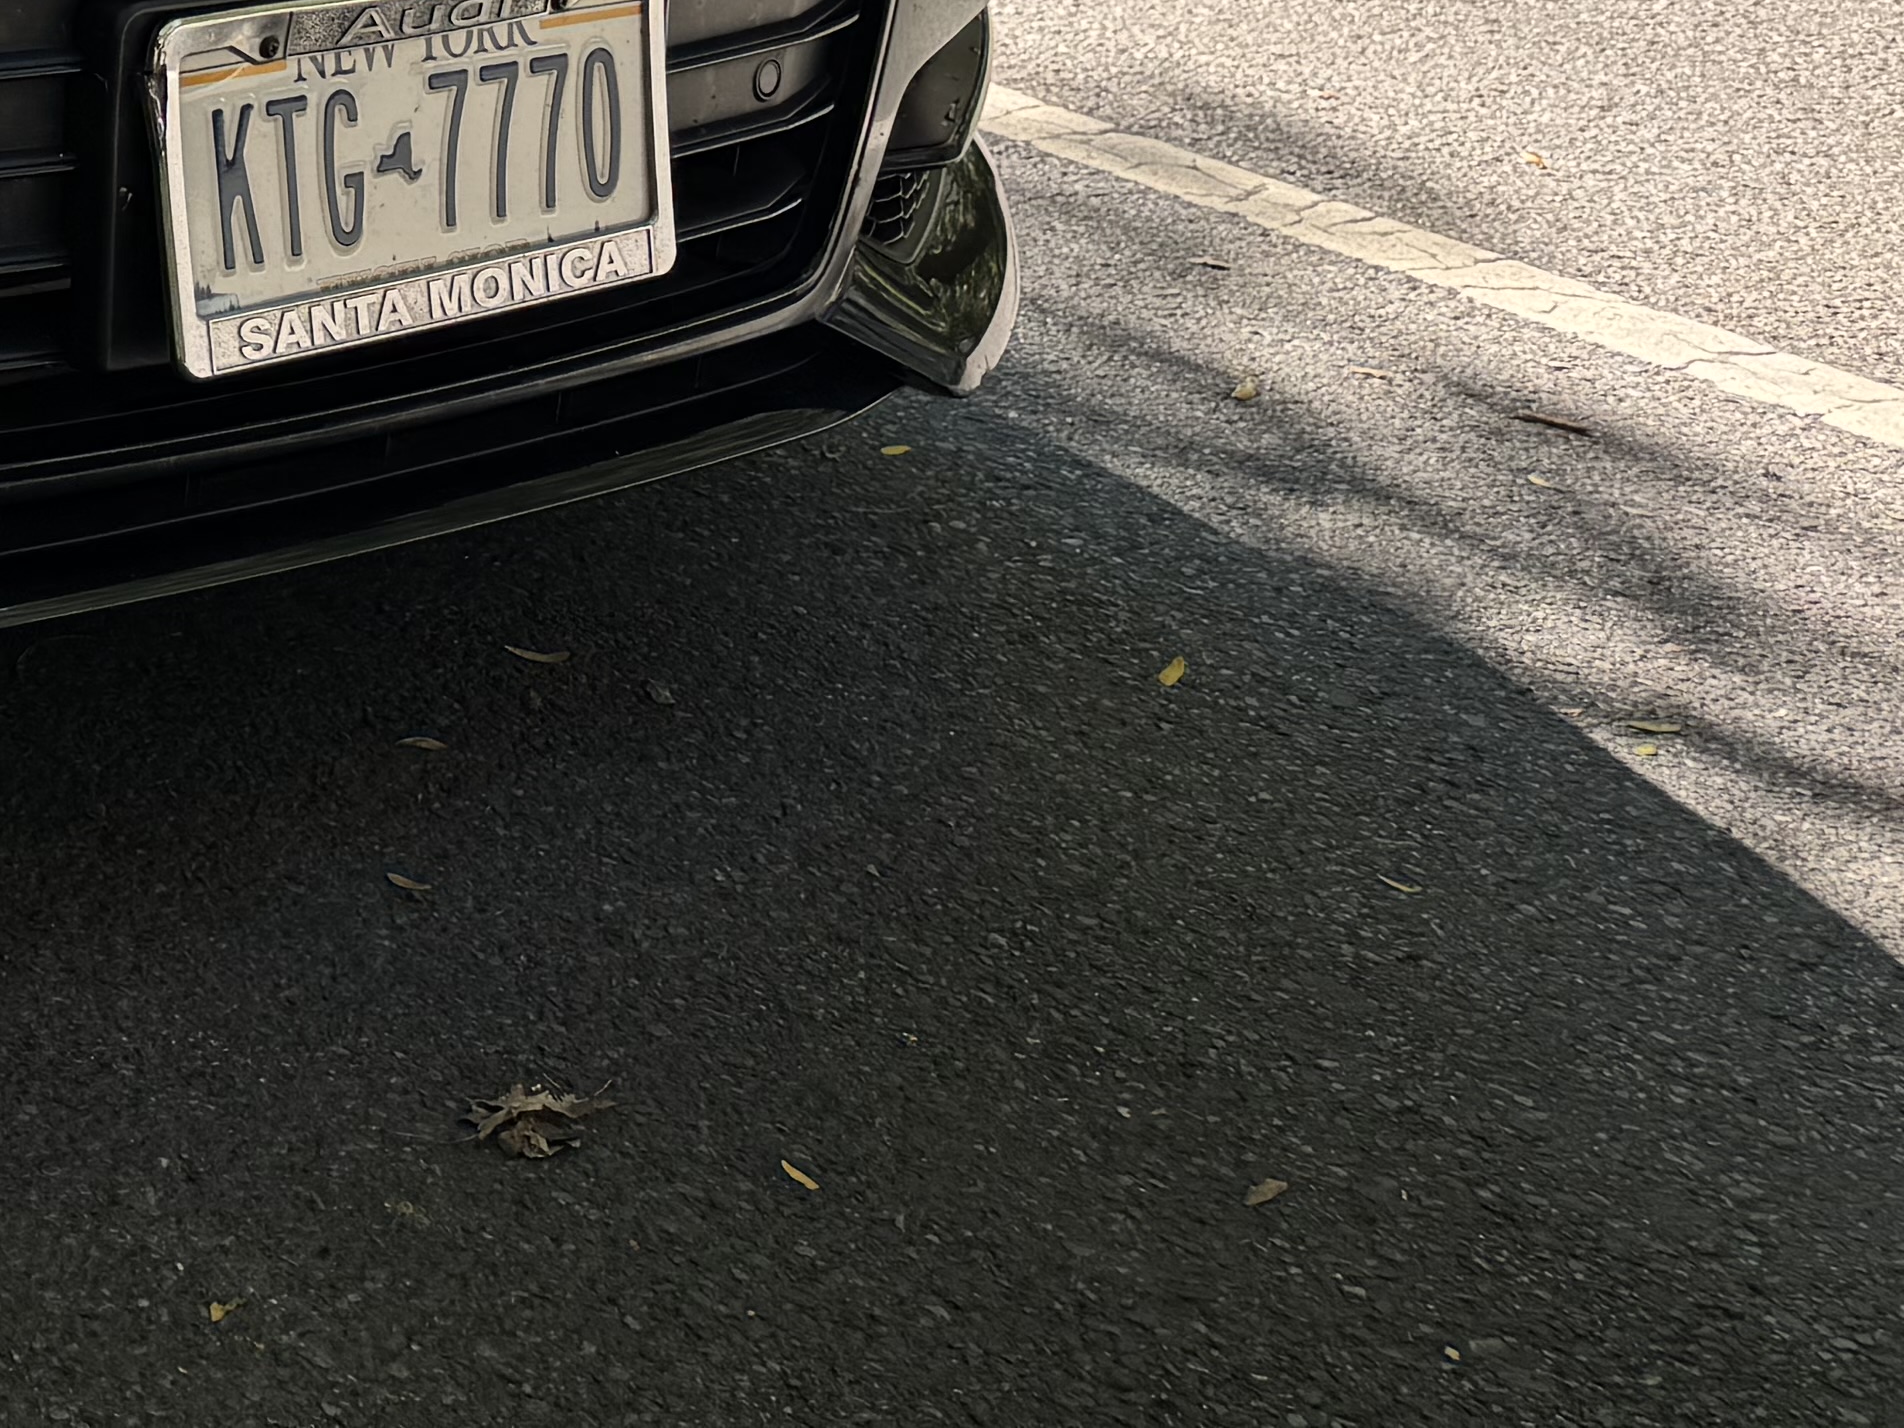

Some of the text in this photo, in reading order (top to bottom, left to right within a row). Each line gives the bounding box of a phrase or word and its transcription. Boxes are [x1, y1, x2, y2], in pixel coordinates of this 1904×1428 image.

[210, 46, 622, 272] KTG 7770
[237, 284, 411, 362] SANTA
[428, 239, 629, 322] MONICA
